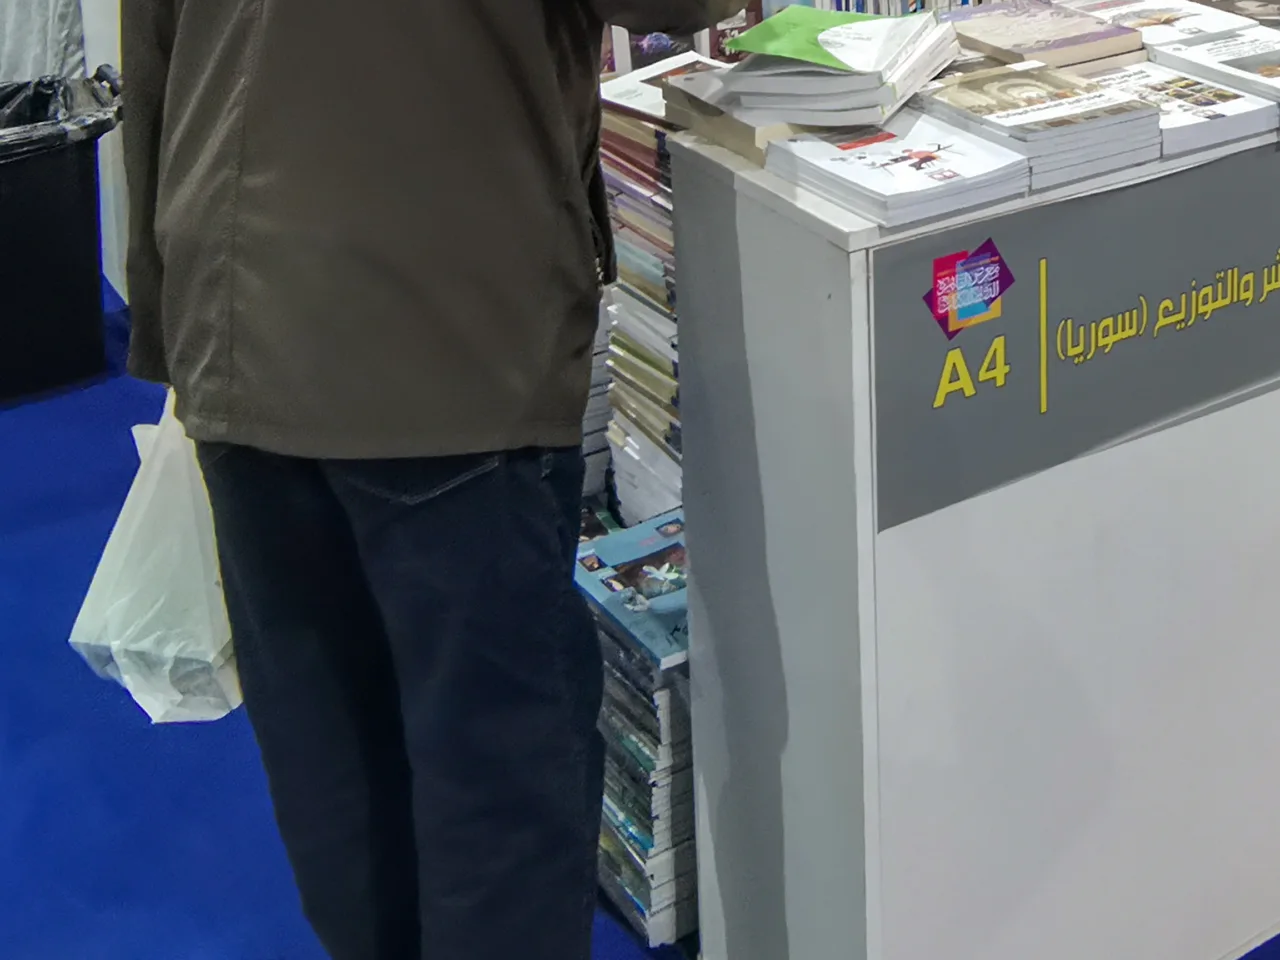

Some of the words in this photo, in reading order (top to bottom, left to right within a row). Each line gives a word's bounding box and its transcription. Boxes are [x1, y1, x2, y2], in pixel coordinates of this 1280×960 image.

[1056, 295, 1148, 365] (سوريا)
[1153, 266, 1255, 339] والتوزيع
[932, 334, 1012, 410] A4
